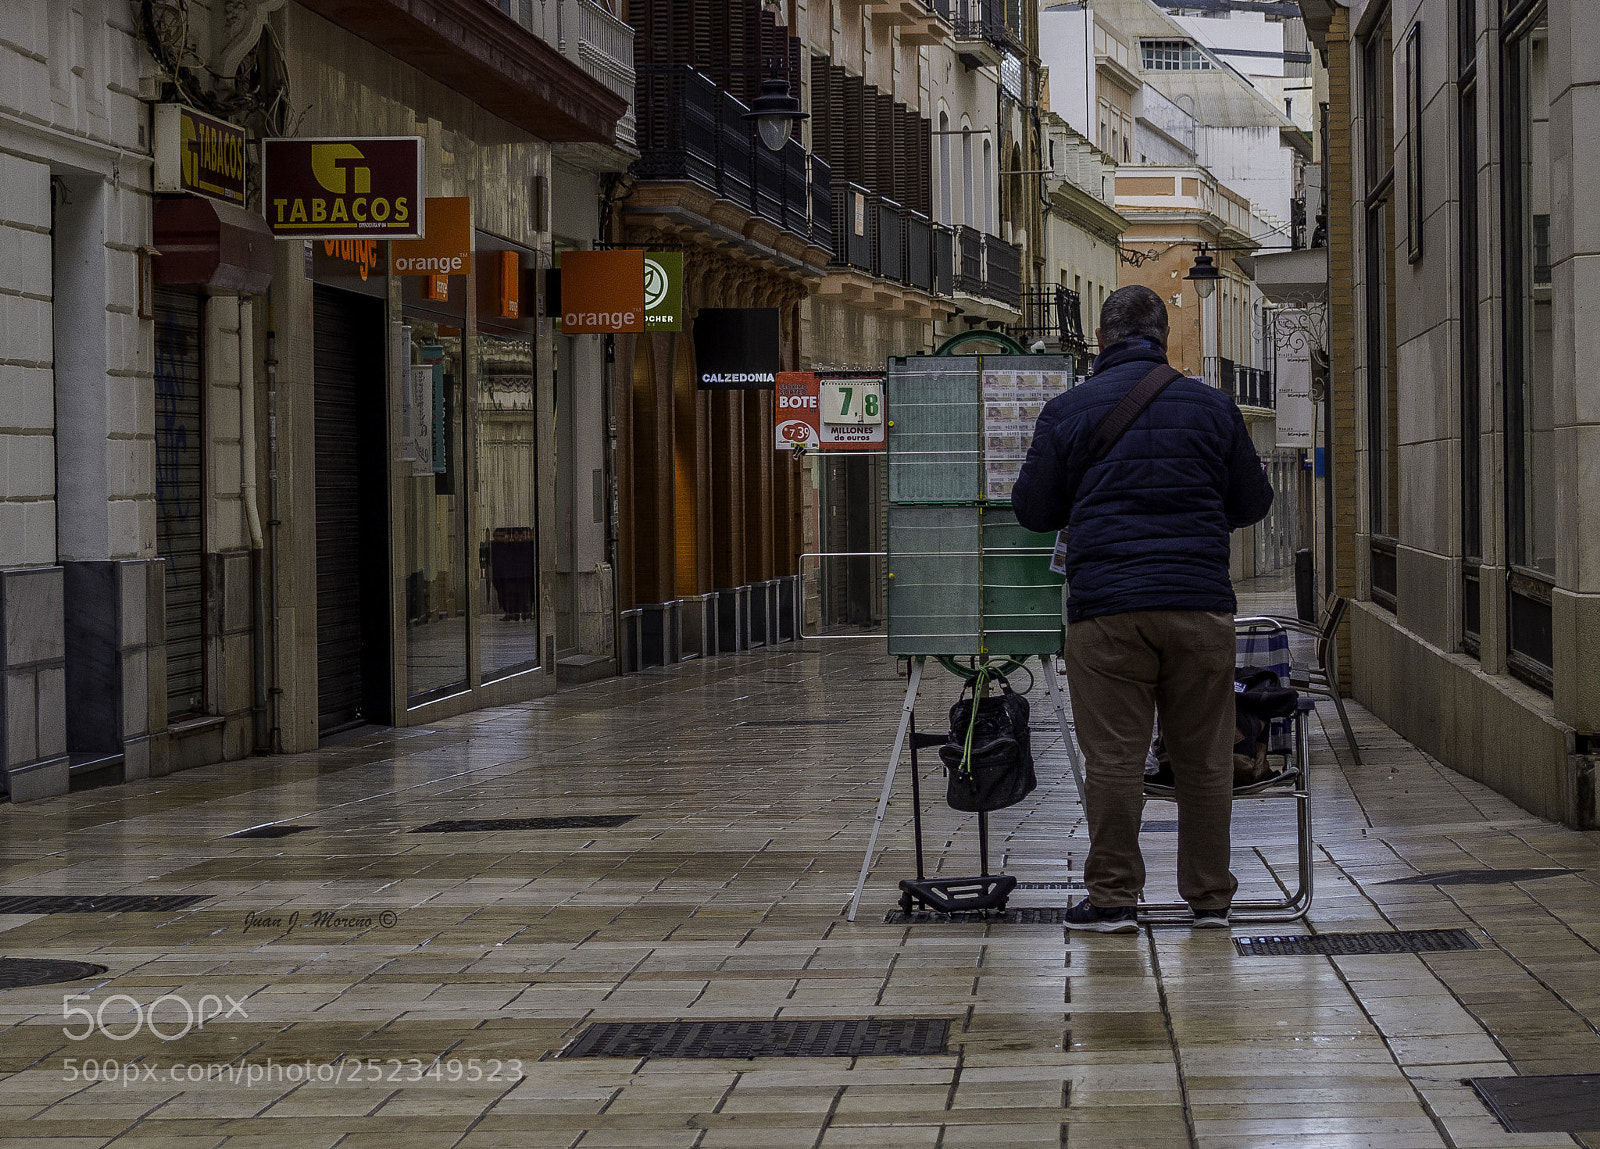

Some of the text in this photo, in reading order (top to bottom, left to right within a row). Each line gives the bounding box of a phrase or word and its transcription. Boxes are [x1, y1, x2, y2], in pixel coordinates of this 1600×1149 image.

[199, 123, 243, 181] TABACOS
[273, 197, 410, 223] TABACOS
[395, 257, 462, 274] orange
[565, 310, 636, 330] orange
[702, 372, 775, 384] CALZEDONIA
[779, 396, 817, 408] BOTE
